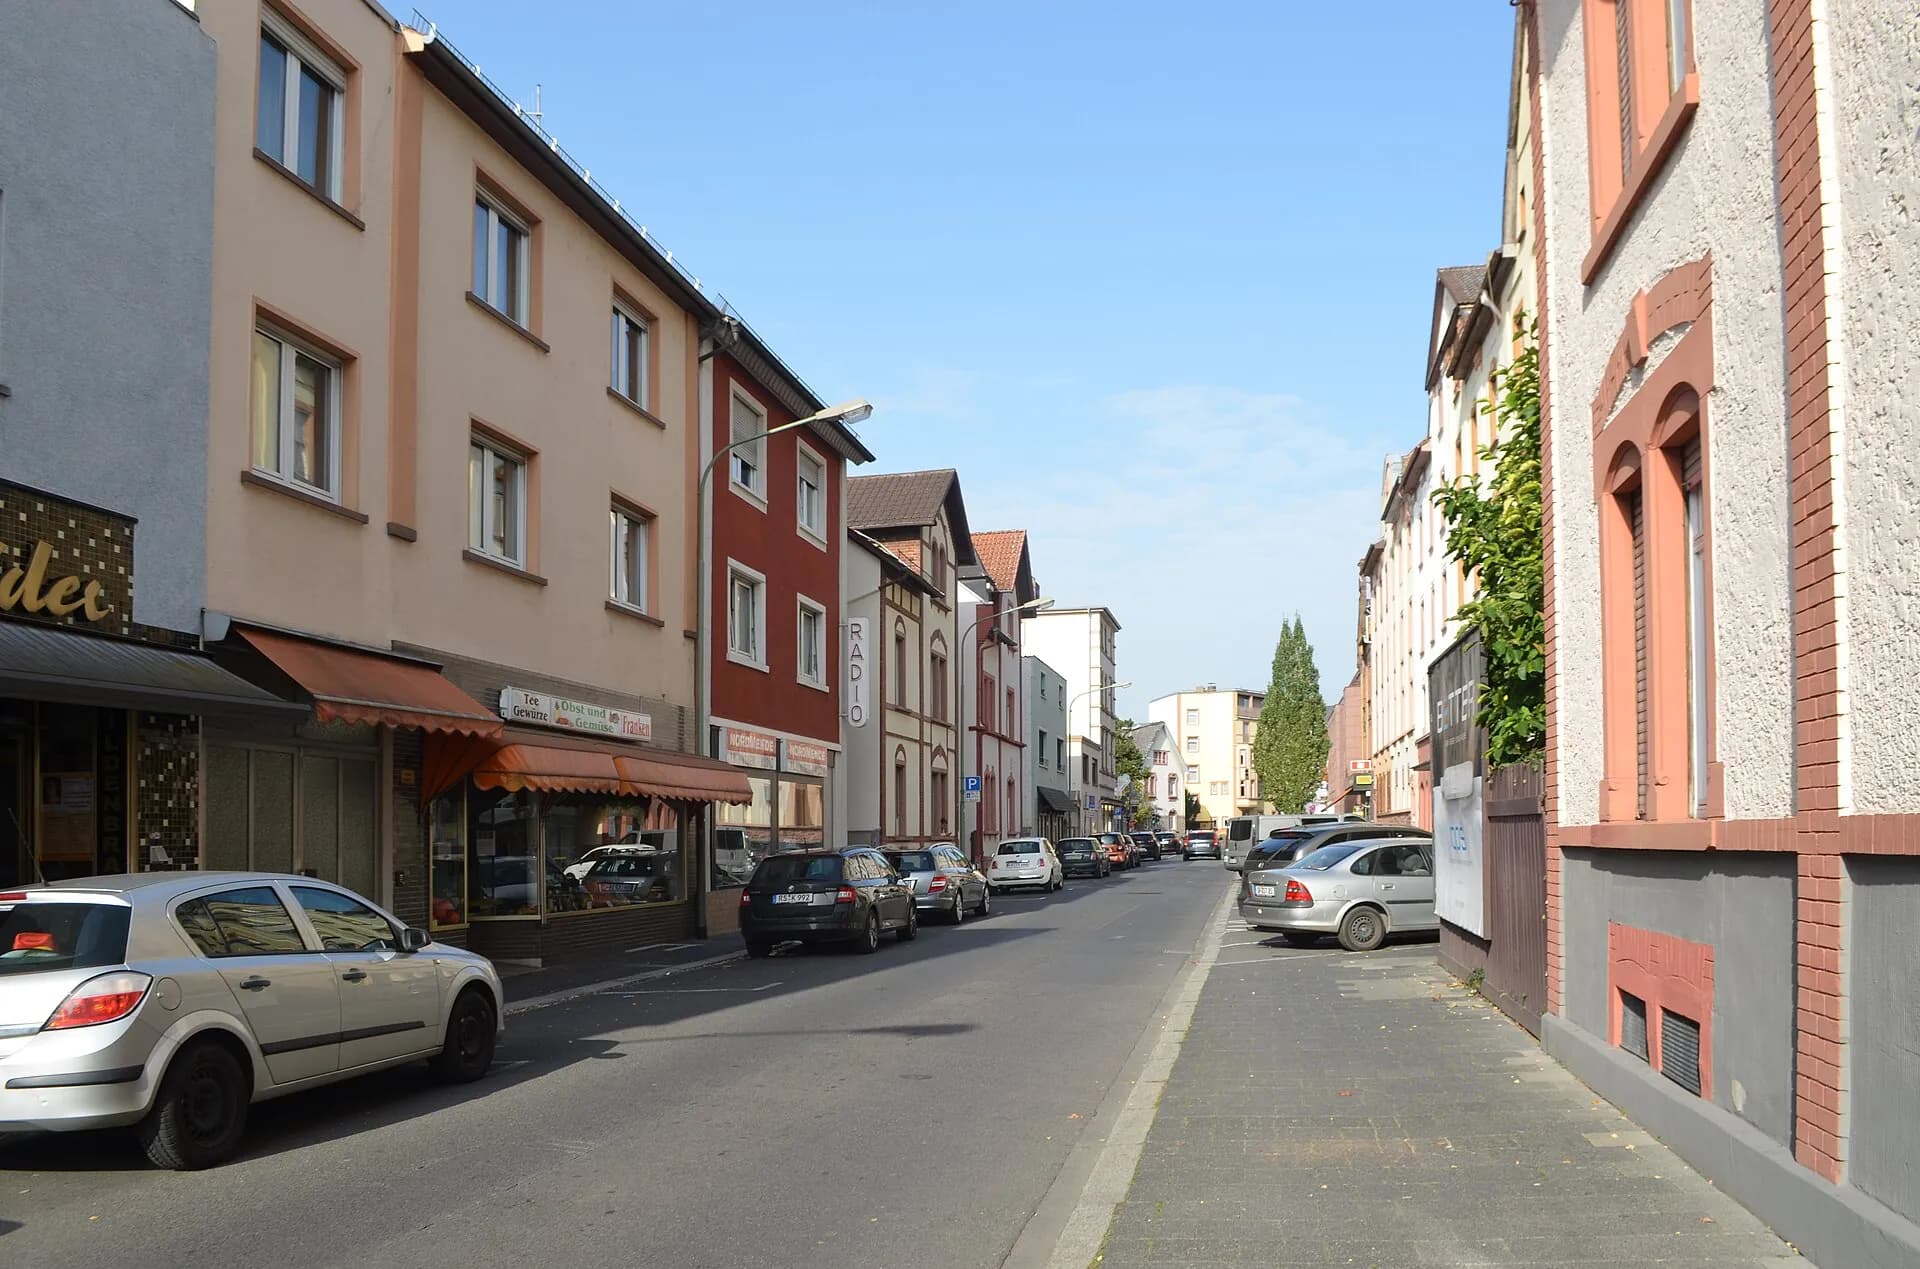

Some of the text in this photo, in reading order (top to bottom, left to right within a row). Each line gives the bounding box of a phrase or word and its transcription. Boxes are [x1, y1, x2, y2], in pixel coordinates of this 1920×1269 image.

[0, 540, 110, 622] der
[850, 623, 864, 722] RADIO
[523, 693, 540, 707] Tee
[513, 705, 549, 722] Gewürze
[561, 701, 606, 719] Obst und
[575, 717, 614, 734] Gemüse
[622, 715, 650, 737] Franken
[968, 778, 977, 790] P
